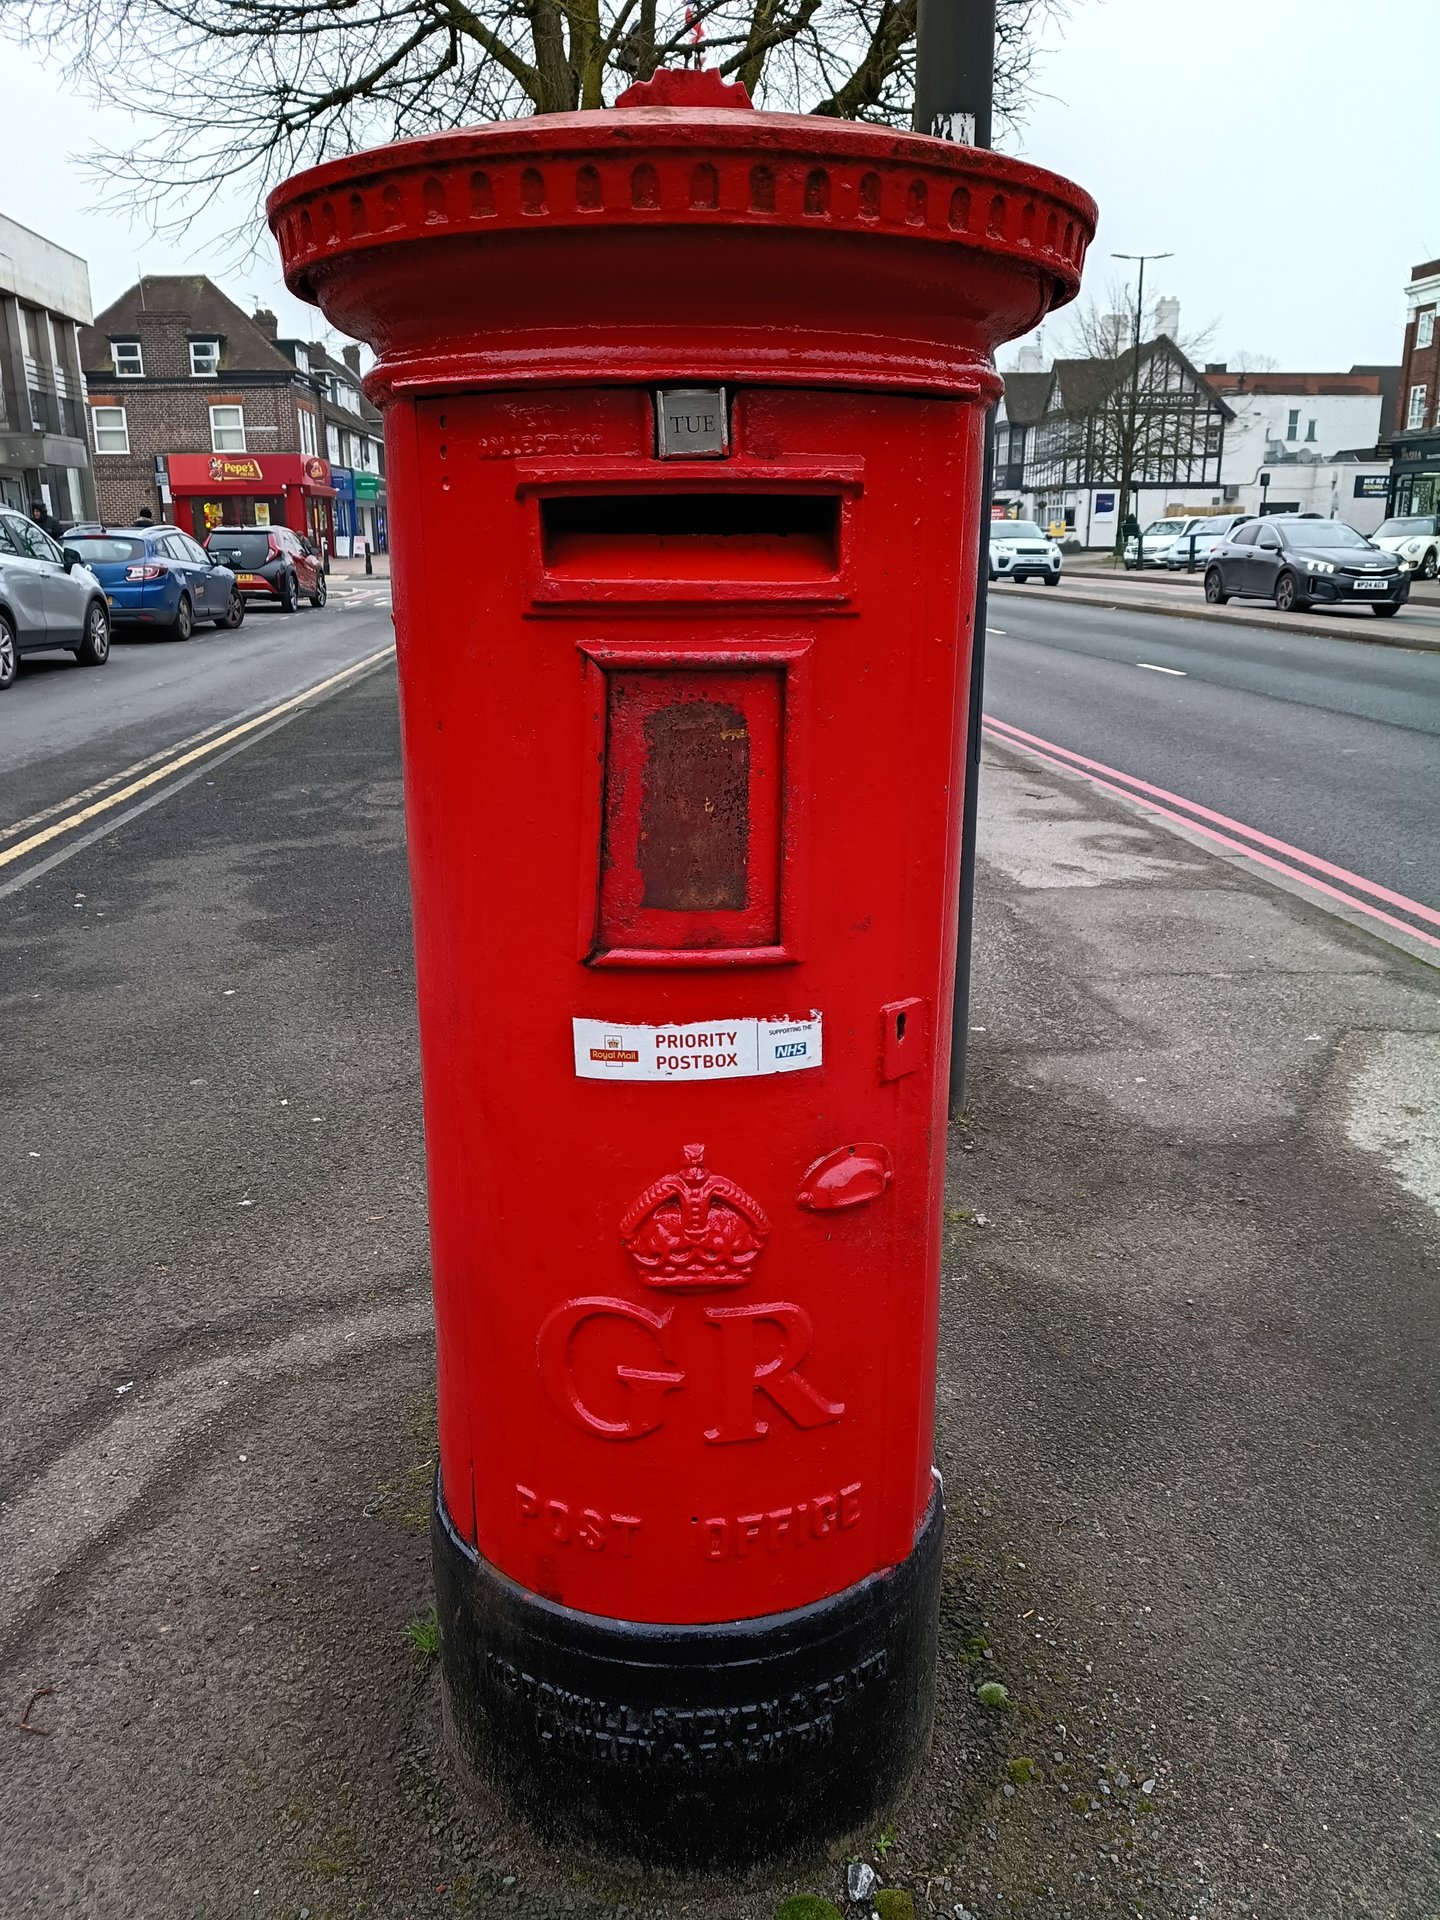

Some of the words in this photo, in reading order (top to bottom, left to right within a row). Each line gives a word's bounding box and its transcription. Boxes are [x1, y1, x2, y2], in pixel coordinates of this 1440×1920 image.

[1170, 395, 1194, 403] HEAD
[669, 414, 716, 434] TUE
[224, 462, 254, 475] Pepe's
[768, 1027, 802, 1036] SUPPORTING
[655, 1031, 738, 1049] PRIORITY
[592, 1050, 616, 1062] Royal
[617, 1051, 636, 1060] Mail
[776, 1043, 805, 1058] NHS
[656, 1053, 739, 1070] POSTBOX
[536, 1296, 846, 1443] GR
[515, 1484, 643, 1558] POST
[703, 1481, 863, 1560] OFFICE
